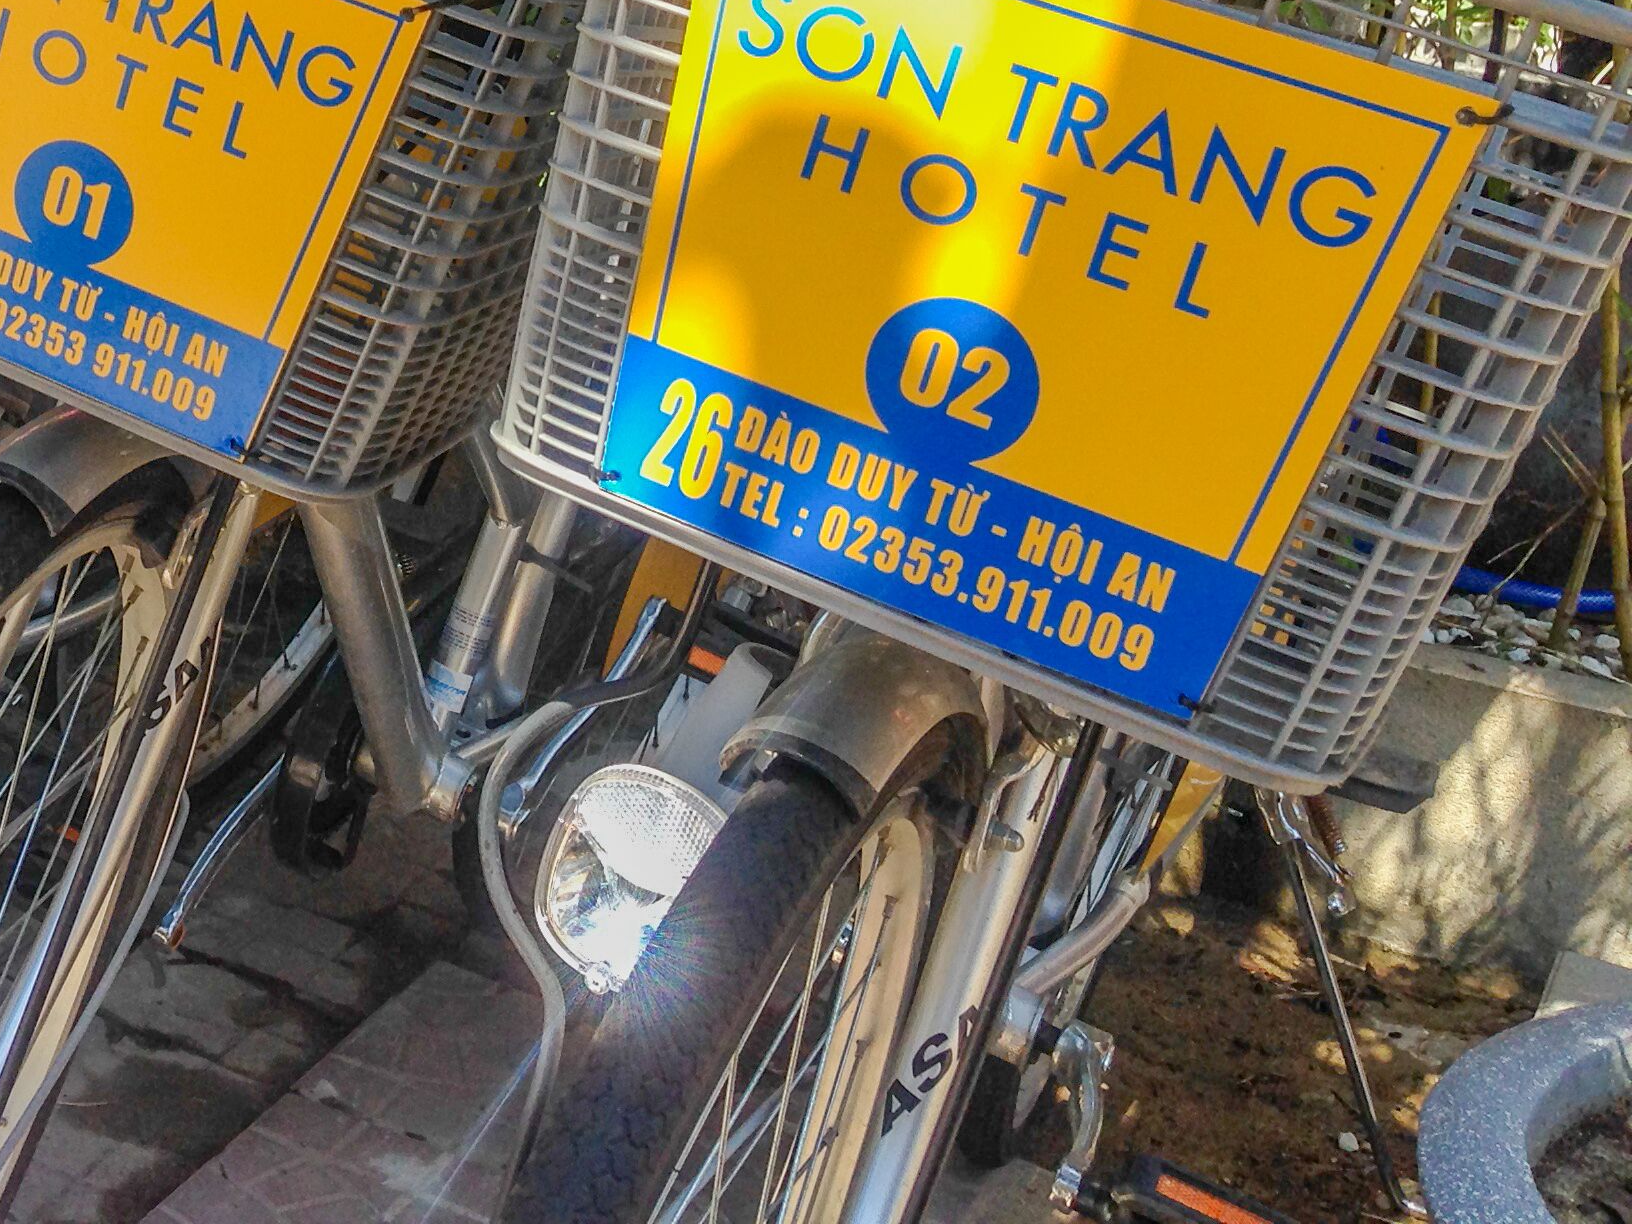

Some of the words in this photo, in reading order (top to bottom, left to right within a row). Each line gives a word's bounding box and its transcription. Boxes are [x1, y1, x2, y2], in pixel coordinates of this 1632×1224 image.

[43, 165, 113, 241] 01
[800, 114, 1210, 319] HOTEL
[1006, 63, 1378, 248] TRANG
[92, 342, 216, 421] 911.009
[182, 332, 229, 378] AN
[899, 328, 1011, 430] 02
[639, 378, 734, 500] 26
[720, 461, 786, 529] TEL
[818, 505, 1155, 672] 02353.911.009
[826, 441, 919, 511] DUY
[1017, 515, 1103, 585] HỘI
[1106, 551, 1177, 614] AN
